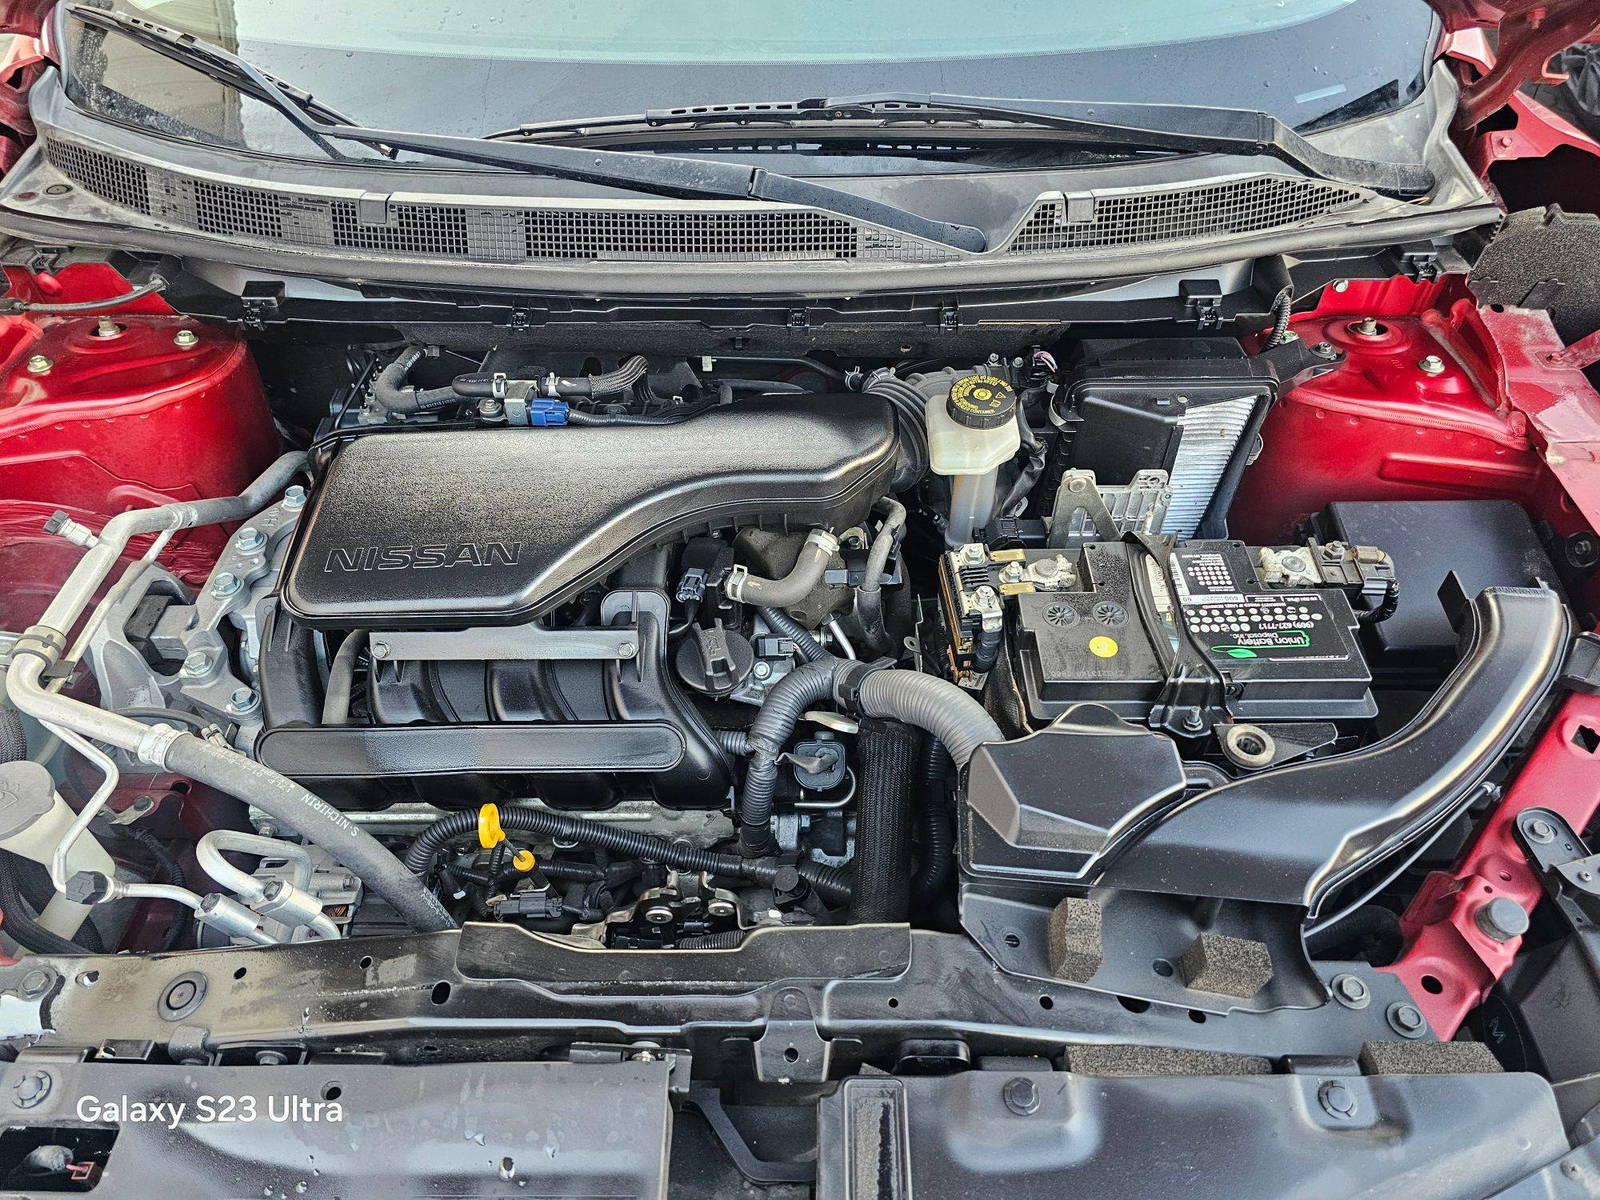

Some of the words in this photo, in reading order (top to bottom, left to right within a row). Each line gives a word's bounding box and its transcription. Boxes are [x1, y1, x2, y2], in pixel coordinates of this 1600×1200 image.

[324, 542, 522, 573] NISSAN
[1237, 637, 1274, 645] Battery
[1275, 636, 1305, 645] Union
